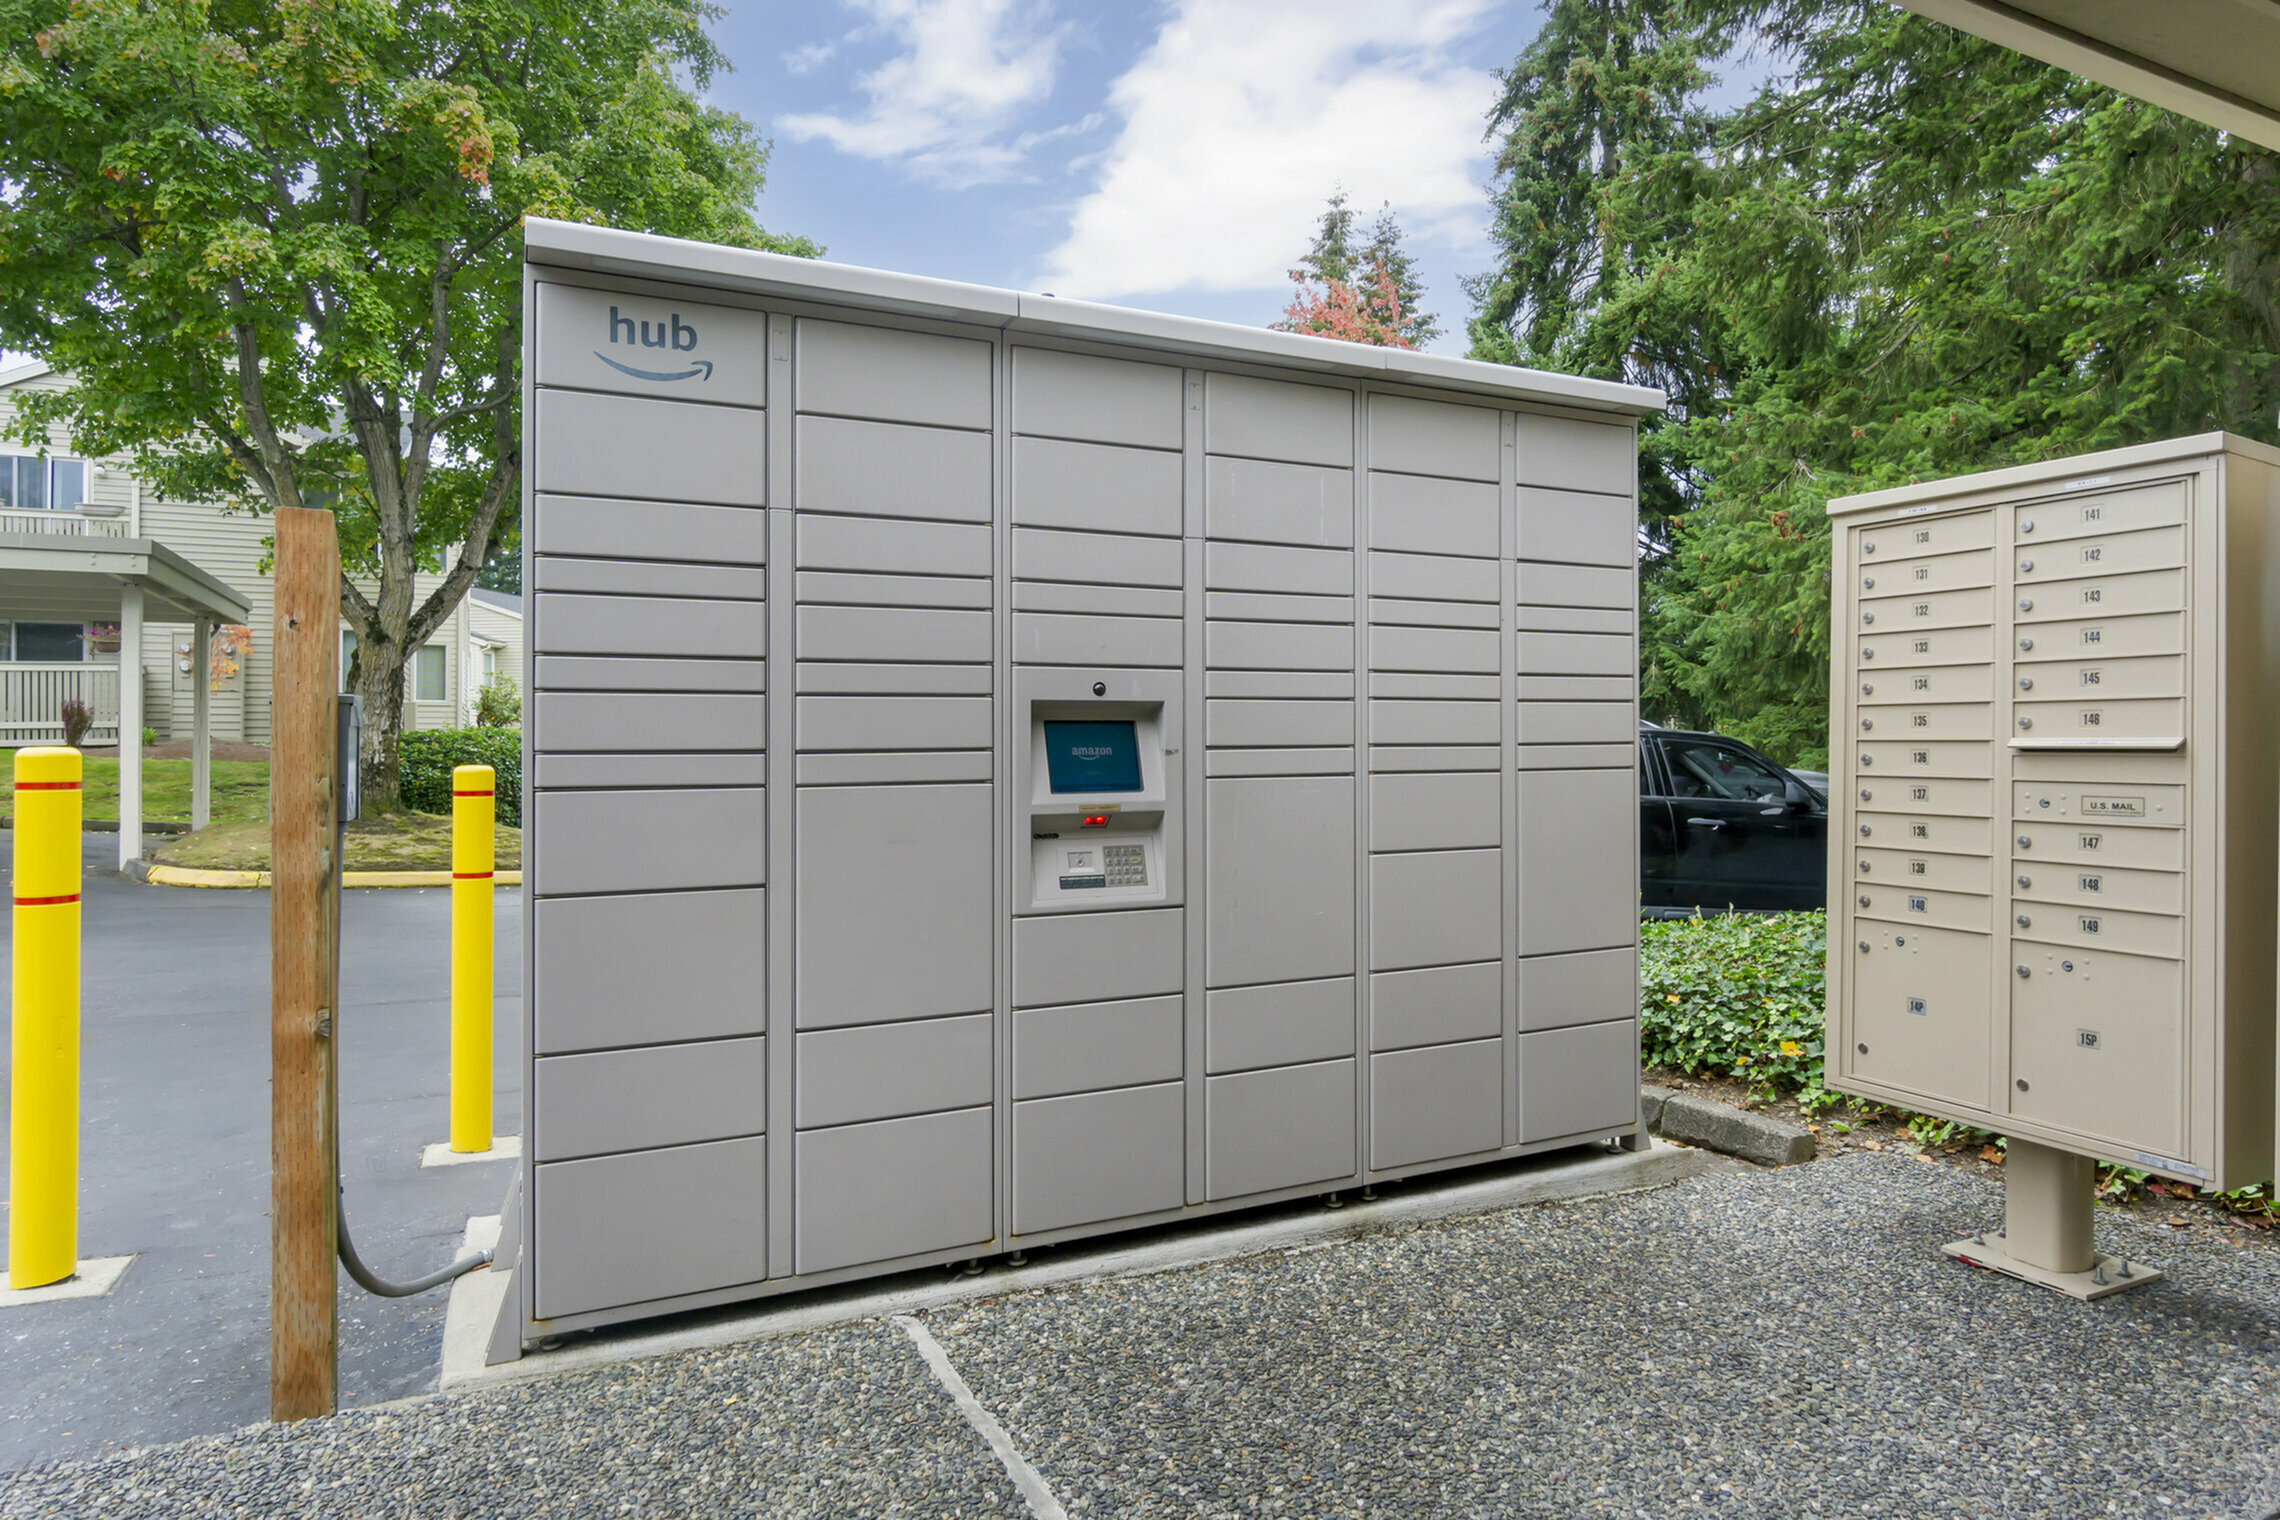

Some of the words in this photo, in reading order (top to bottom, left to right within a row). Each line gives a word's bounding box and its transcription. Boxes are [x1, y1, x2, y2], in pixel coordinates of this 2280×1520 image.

[610, 306, 697, 351] hub
[2085, 508, 2100, 521] 141
[1916, 532, 1929, 543] 130
[2084, 548, 2100, 562] 142
[1915, 569, 1928, 579] 131
[2084, 590, 2100, 603] 143
[1915, 605, 1928, 616] 132
[2084, 631, 2100, 643] 144
[1915, 642, 1928, 653] 133
[2083, 672, 2100, 684] 145
[1914, 679, 1928, 690] 134
[1914, 716, 1927, 726] 135
[2083, 713, 2100, 725] 146
[1071, 746, 1112, 756] amazon
[1913, 789, 1926, 800] 137
[2090, 802, 2109, 810] U.S.
[1913, 825, 1926, 837] 138
[2082, 836, 2099, 849] 147
[2082, 878, 2099, 891] 148
[1911, 899, 1925, 911] 140
[2081, 919, 2099, 933] 149
[1910, 1000, 1924, 1012] 14P
[2080, 1032, 2097, 1046] 15P
